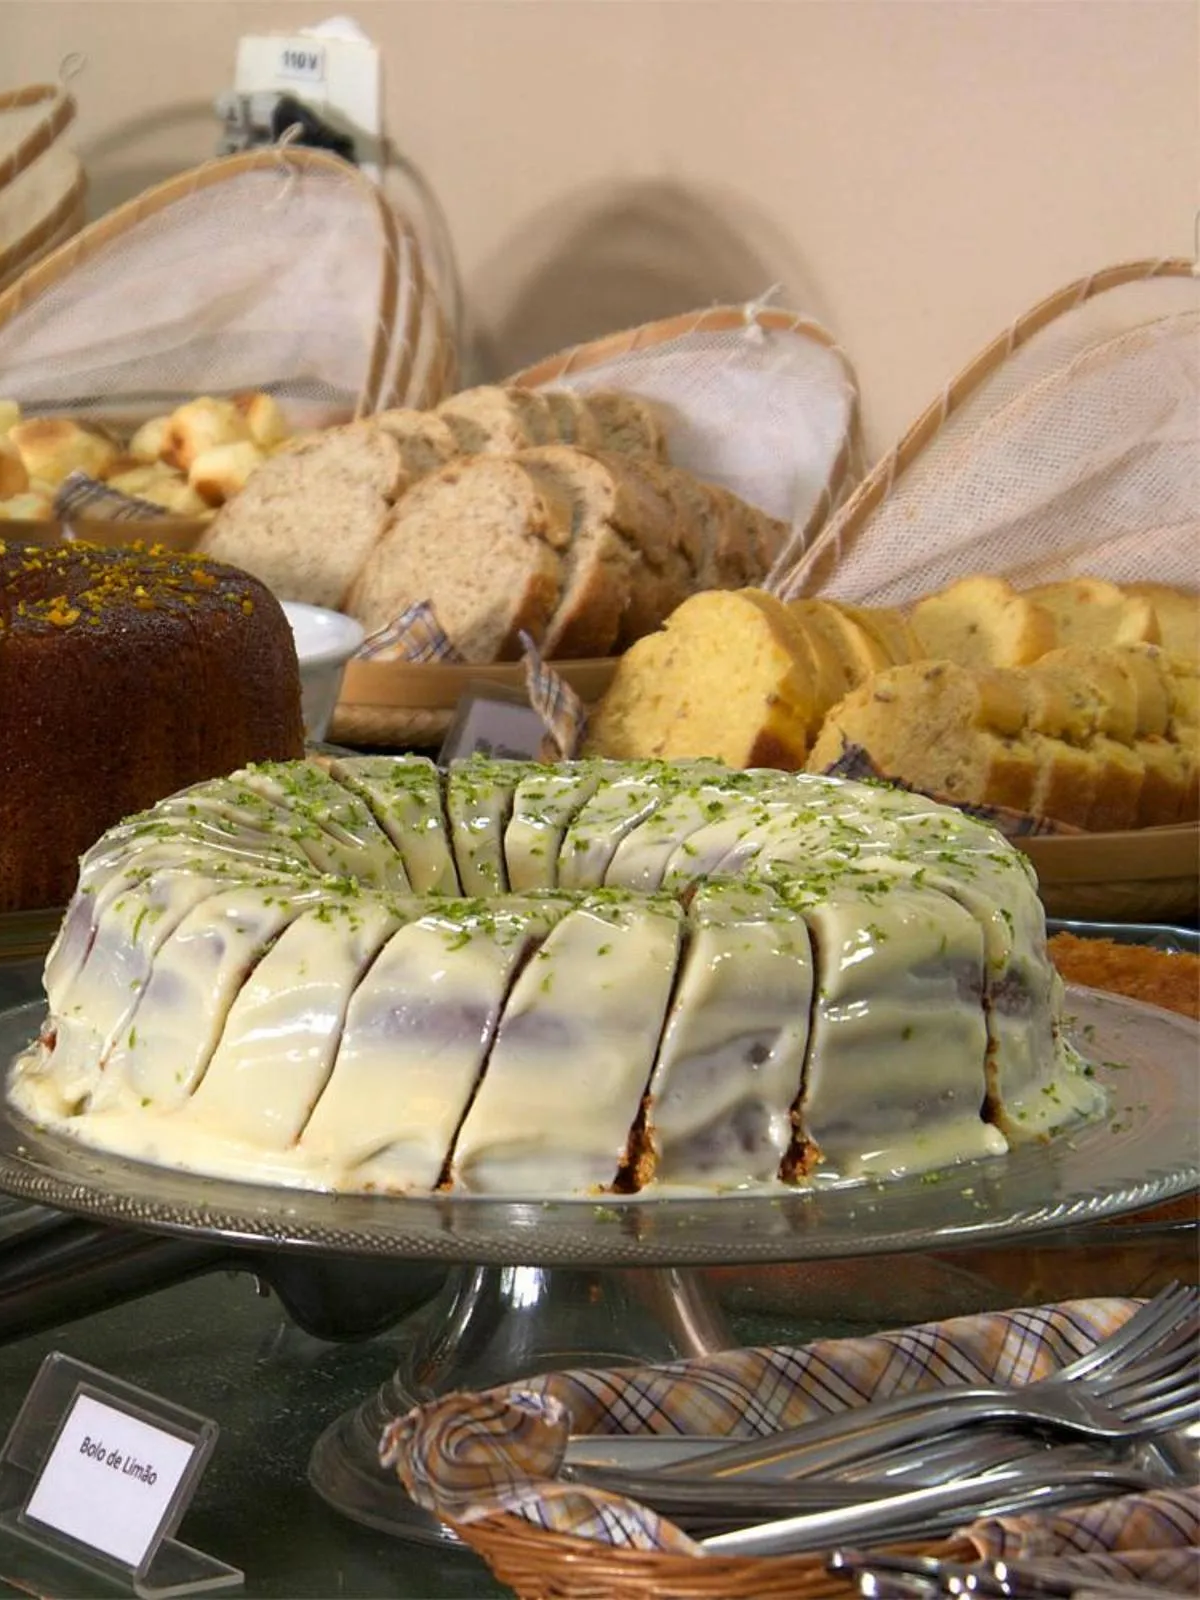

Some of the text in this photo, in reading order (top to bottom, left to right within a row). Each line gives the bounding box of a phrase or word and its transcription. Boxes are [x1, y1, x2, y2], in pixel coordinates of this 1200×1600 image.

[80, 1436, 158, 1486] Bolo de Limão
